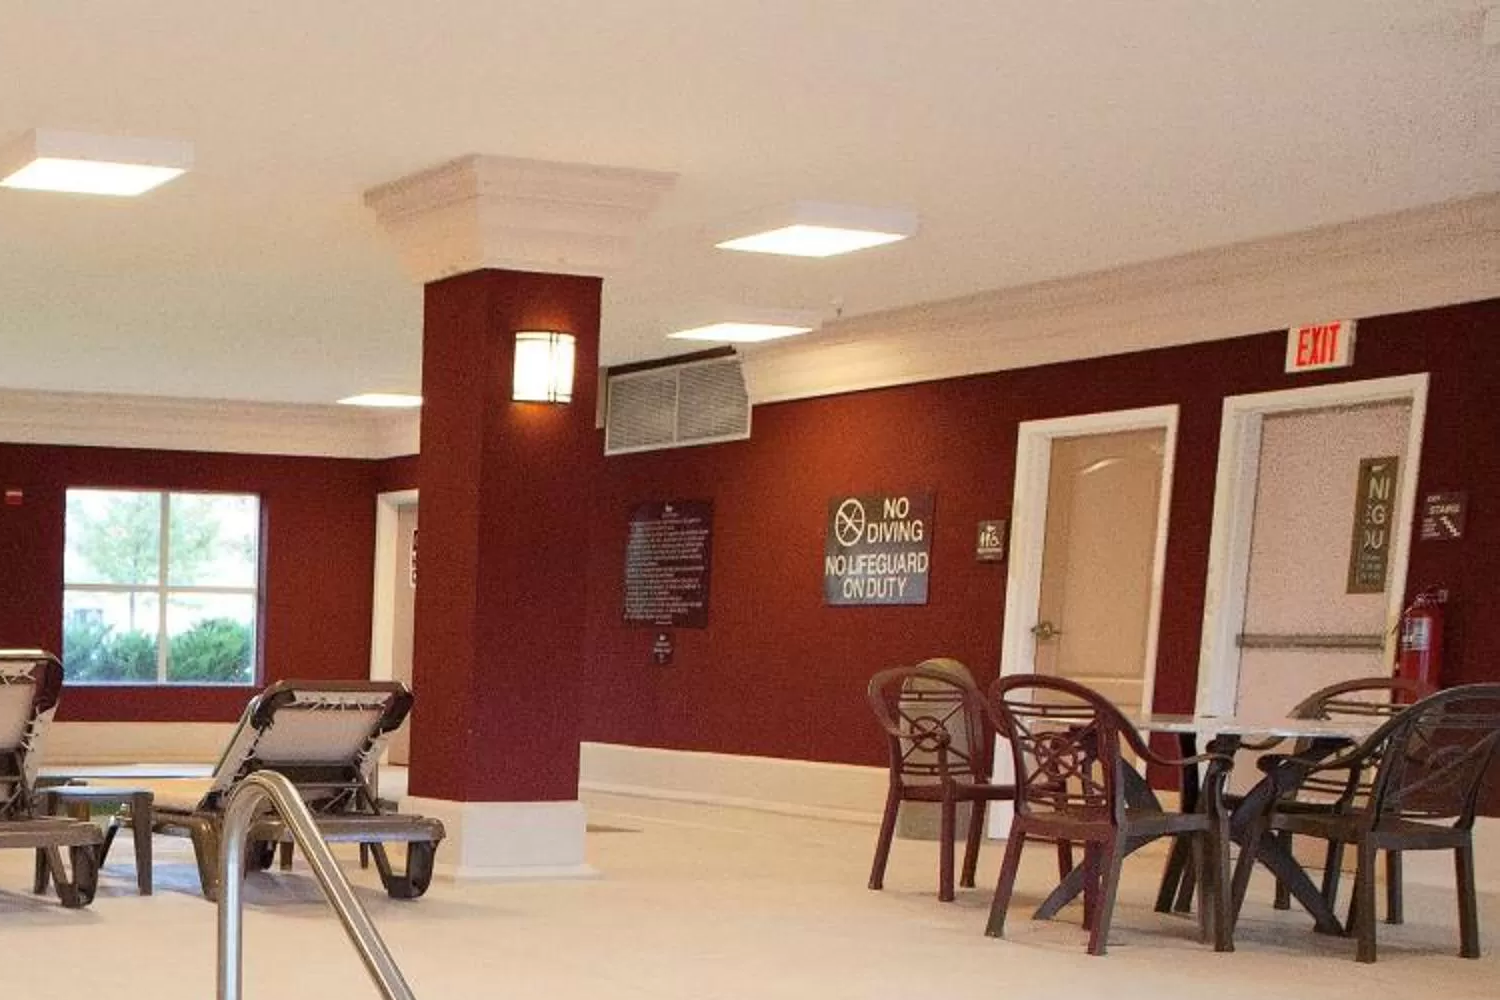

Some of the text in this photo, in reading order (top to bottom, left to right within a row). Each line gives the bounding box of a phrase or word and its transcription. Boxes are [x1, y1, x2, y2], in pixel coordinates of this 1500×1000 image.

[1296, 321, 1340, 366] EXIT
[883, 497, 909, 519] NO
[867, 520, 923, 543] DIVING
[825, 552, 928, 576] NO LIFEGUARD
[843, 577, 906, 598] ON DUTY
